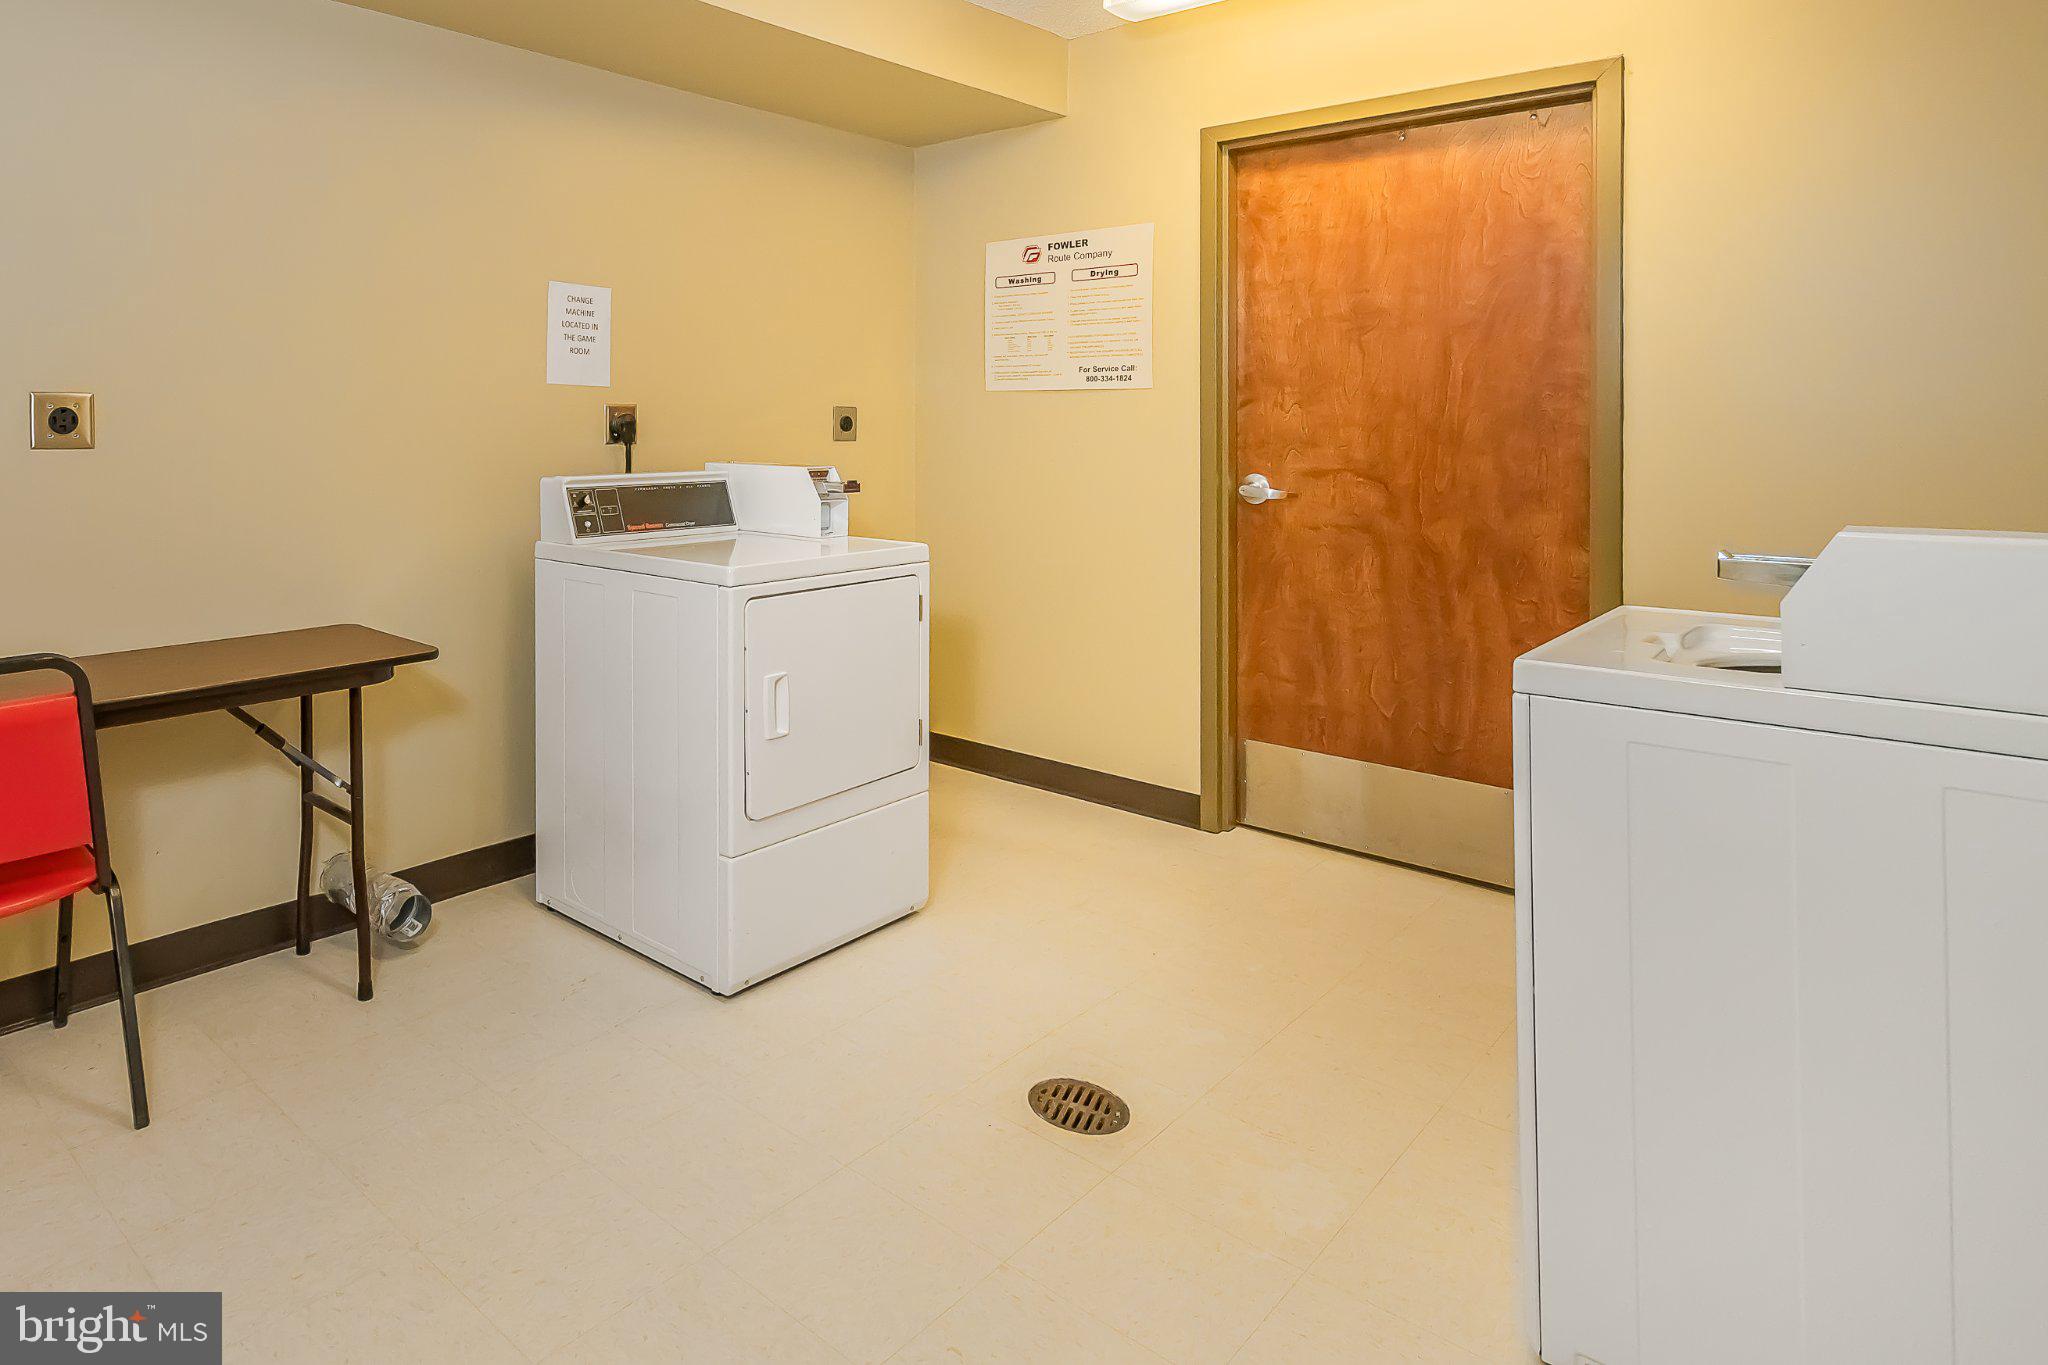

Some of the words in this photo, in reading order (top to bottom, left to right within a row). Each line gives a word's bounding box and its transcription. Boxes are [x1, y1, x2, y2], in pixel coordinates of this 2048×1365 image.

[1047, 238, 1089, 251] FOWLER
[1047, 253, 1071, 263] Route
[1073, 249, 1113, 262] Company
[1090, 268, 1119, 278] Drying
[1008, 276, 1042, 285] Washing
[567, 295, 594, 305] CHANGE
[565, 308, 595, 318] MACHINE
[561, 320, 590, 330] LOCATED
[591, 323, 599, 331] IN
[563, 333, 575, 342] THE
[576, 334, 597, 343] GAME
[569, 347, 591, 355] ROOM
[1092, 365, 1119, 373] Service
